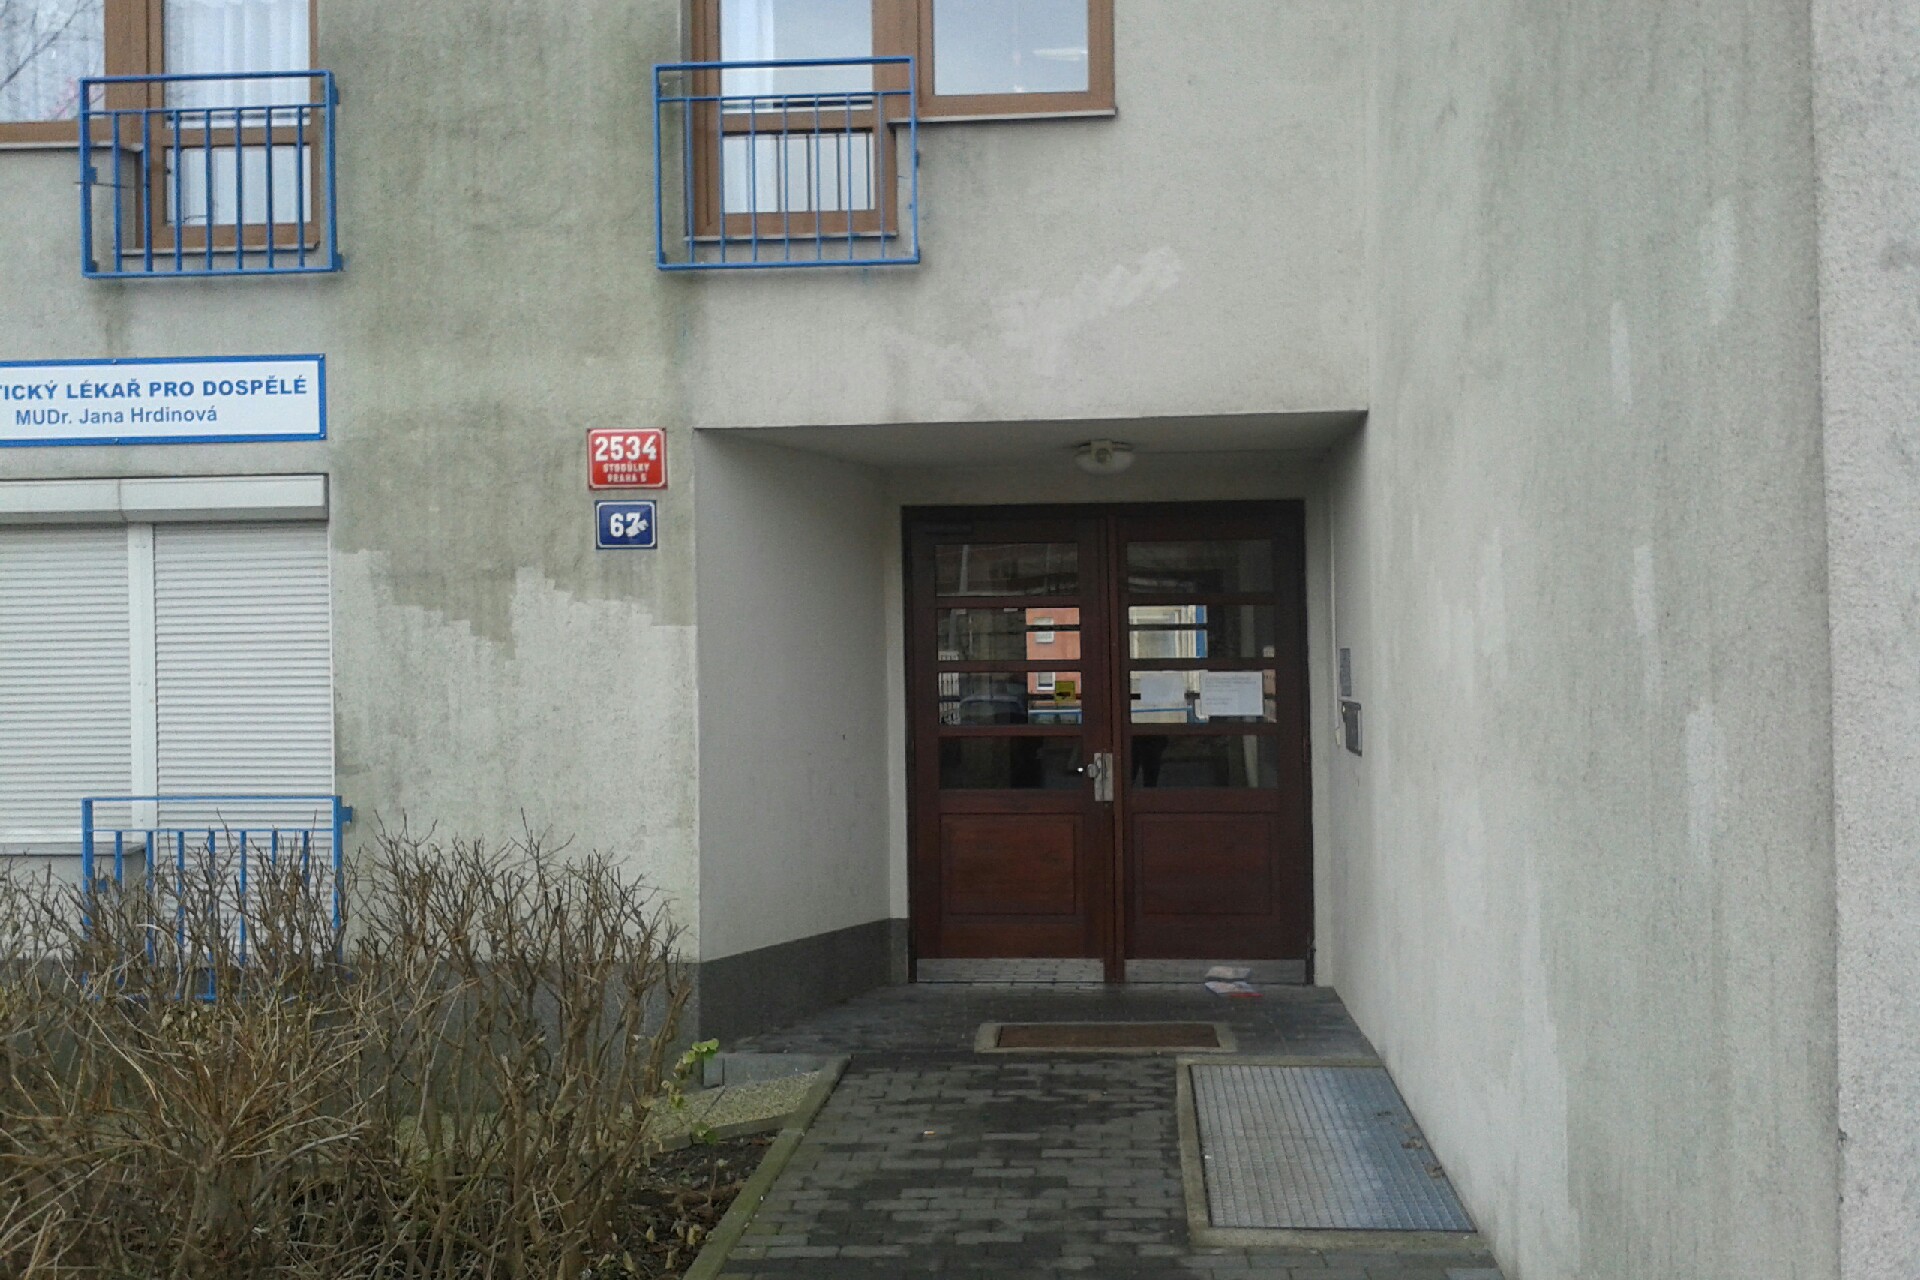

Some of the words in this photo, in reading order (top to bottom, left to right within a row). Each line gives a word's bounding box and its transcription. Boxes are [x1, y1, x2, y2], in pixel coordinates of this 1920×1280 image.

[0, 380, 58, 400] ICKÝ
[66, 378, 141, 399] LÉKAŘ
[149, 380, 195, 398] PRO
[203, 375, 308, 396] DOSPĚLÉ
[16, 409, 72, 426] MUDr.
[79, 408, 124, 424] Jana
[131, 405, 218, 423] Hrdinová
[595, 435, 657, 461] 2534
